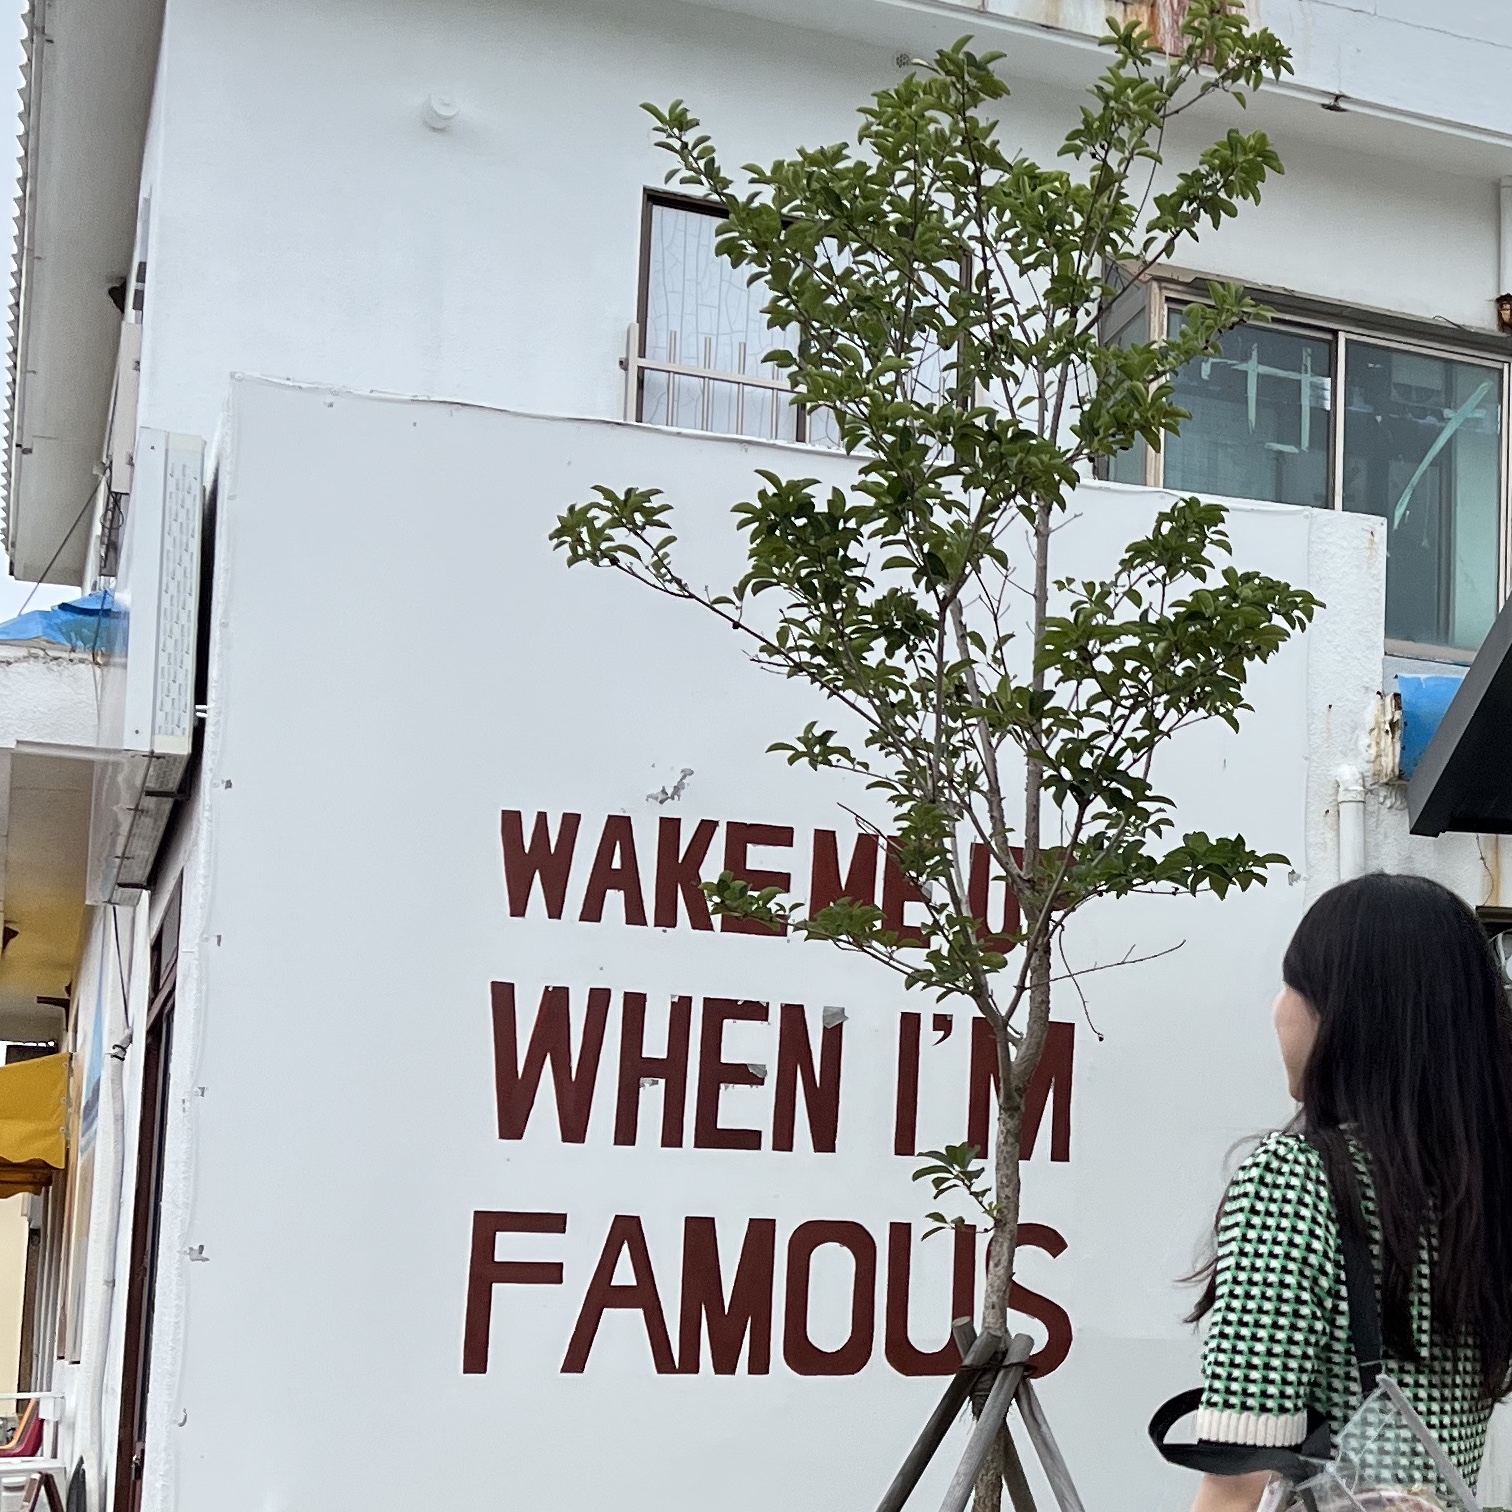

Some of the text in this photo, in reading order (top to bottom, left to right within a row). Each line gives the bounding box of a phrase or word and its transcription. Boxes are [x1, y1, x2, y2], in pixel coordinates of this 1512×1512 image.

[501, 810, 794, 937] WAKE
[490, 980, 1075, 1163] WHEN I'M
[463, 1209, 1074, 1378] FAMOUS
